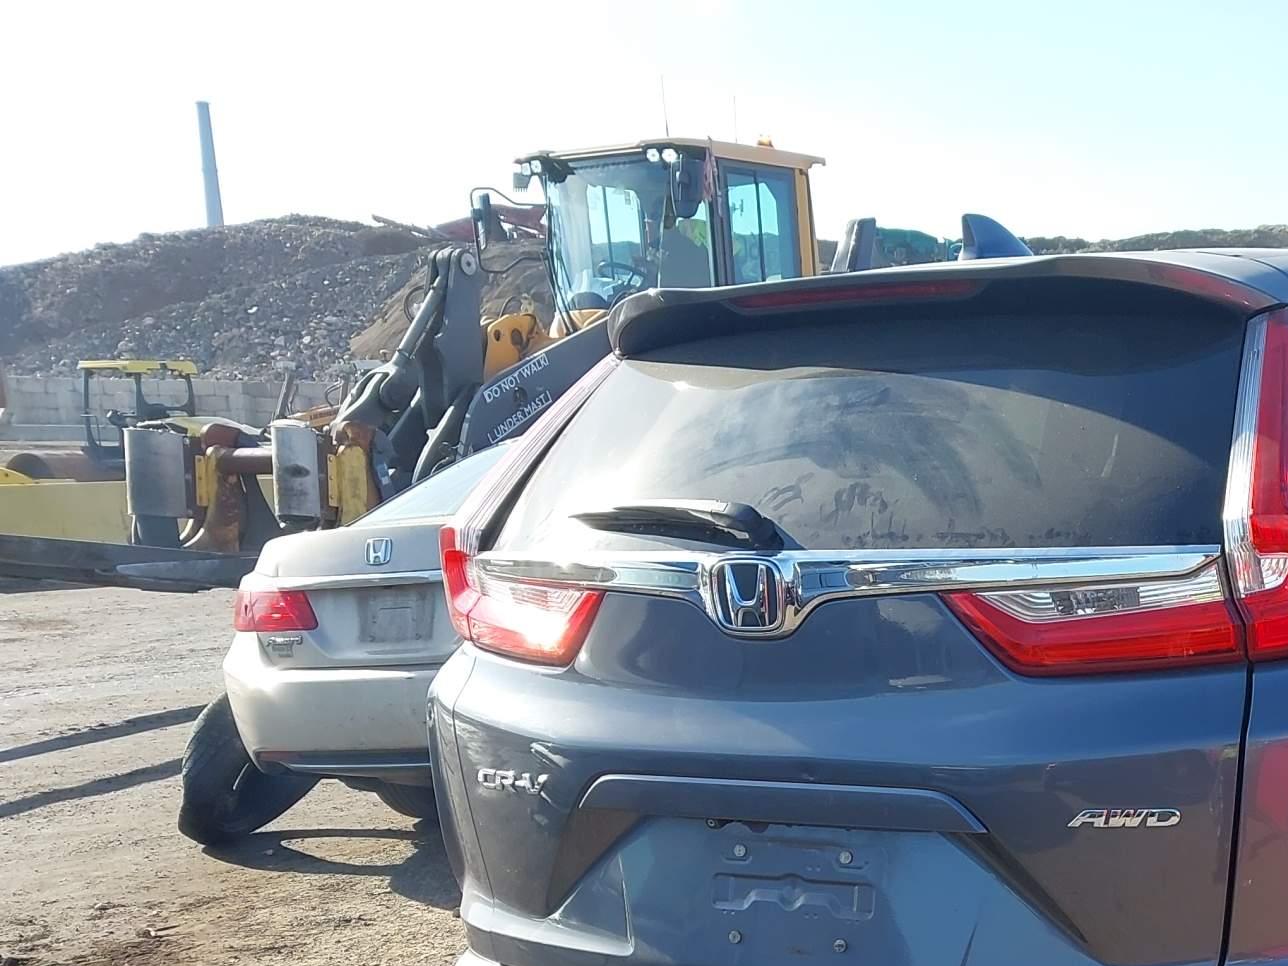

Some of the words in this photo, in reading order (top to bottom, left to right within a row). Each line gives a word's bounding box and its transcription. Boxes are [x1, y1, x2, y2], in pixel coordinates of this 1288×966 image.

[485, 386, 501, 402] DO
[501, 371, 521, 393] NOT
[520, 353, 548, 379] WALK
[494, 410, 525, 438] UNDER
[523, 393, 547, 417] MAST
[477, 768, 549, 795] CR-V
[1067, 808, 1181, 828] AWD
